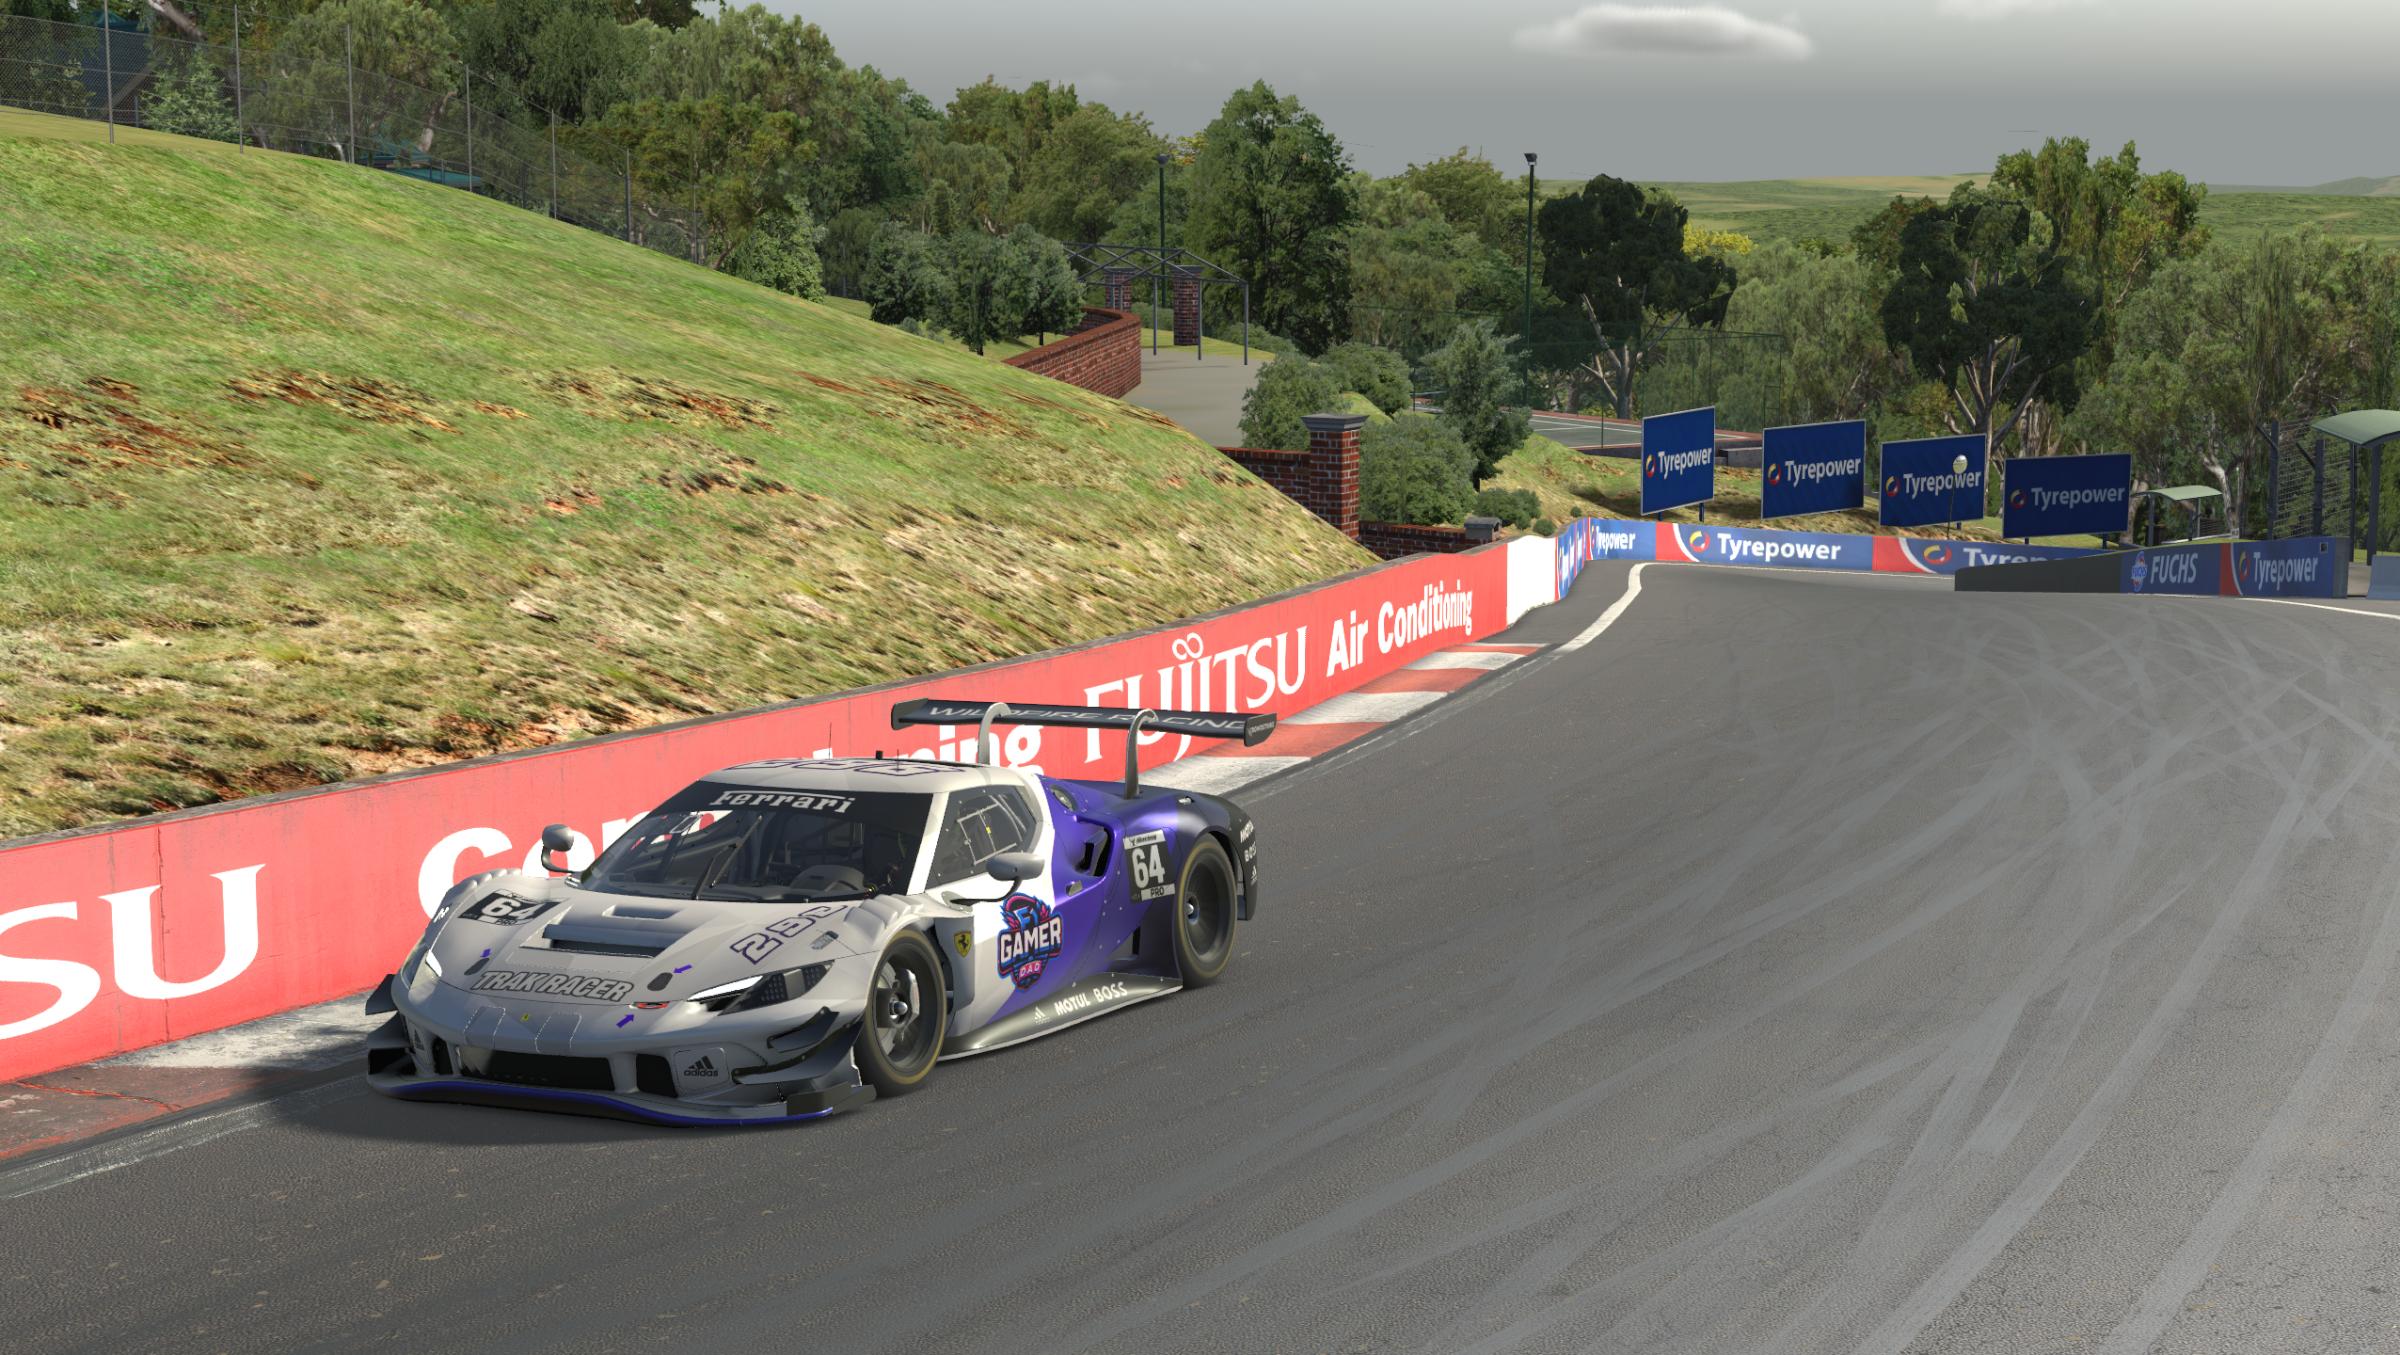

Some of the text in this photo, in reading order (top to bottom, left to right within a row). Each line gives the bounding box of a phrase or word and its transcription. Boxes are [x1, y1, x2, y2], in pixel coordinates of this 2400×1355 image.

[1658, 448, 1712, 480] Tyrepower
[1785, 458, 1861, 488] Tyrepower
[1903, 471, 1982, 500] Tyrepower
[2031, 487, 2126, 511] Tyrepower
[1717, 532, 1842, 562] Tyrepower
[2150, 552, 2199, 585] FUCHS
[2253, 551, 2319, 591] Tyrepower
[1326, 609, 1369, 677] Air
[1377, 578, 1473, 654] Conditioning
[709, 789, 856, 813] Ferrari
[1131, 843, 1166, 889] 64
[1150, 886, 1165, 897] PRO
[480, 896, 546, 920] 64
[1000, 916, 1062, 963] GAMER
[1020, 962, 1042, 977] DAD
[470, 970, 635, 1003] TRAK RACER
[1054, 981, 1128, 1016] MOTUL BOSS
[683, 1069, 719, 1077] adidas
